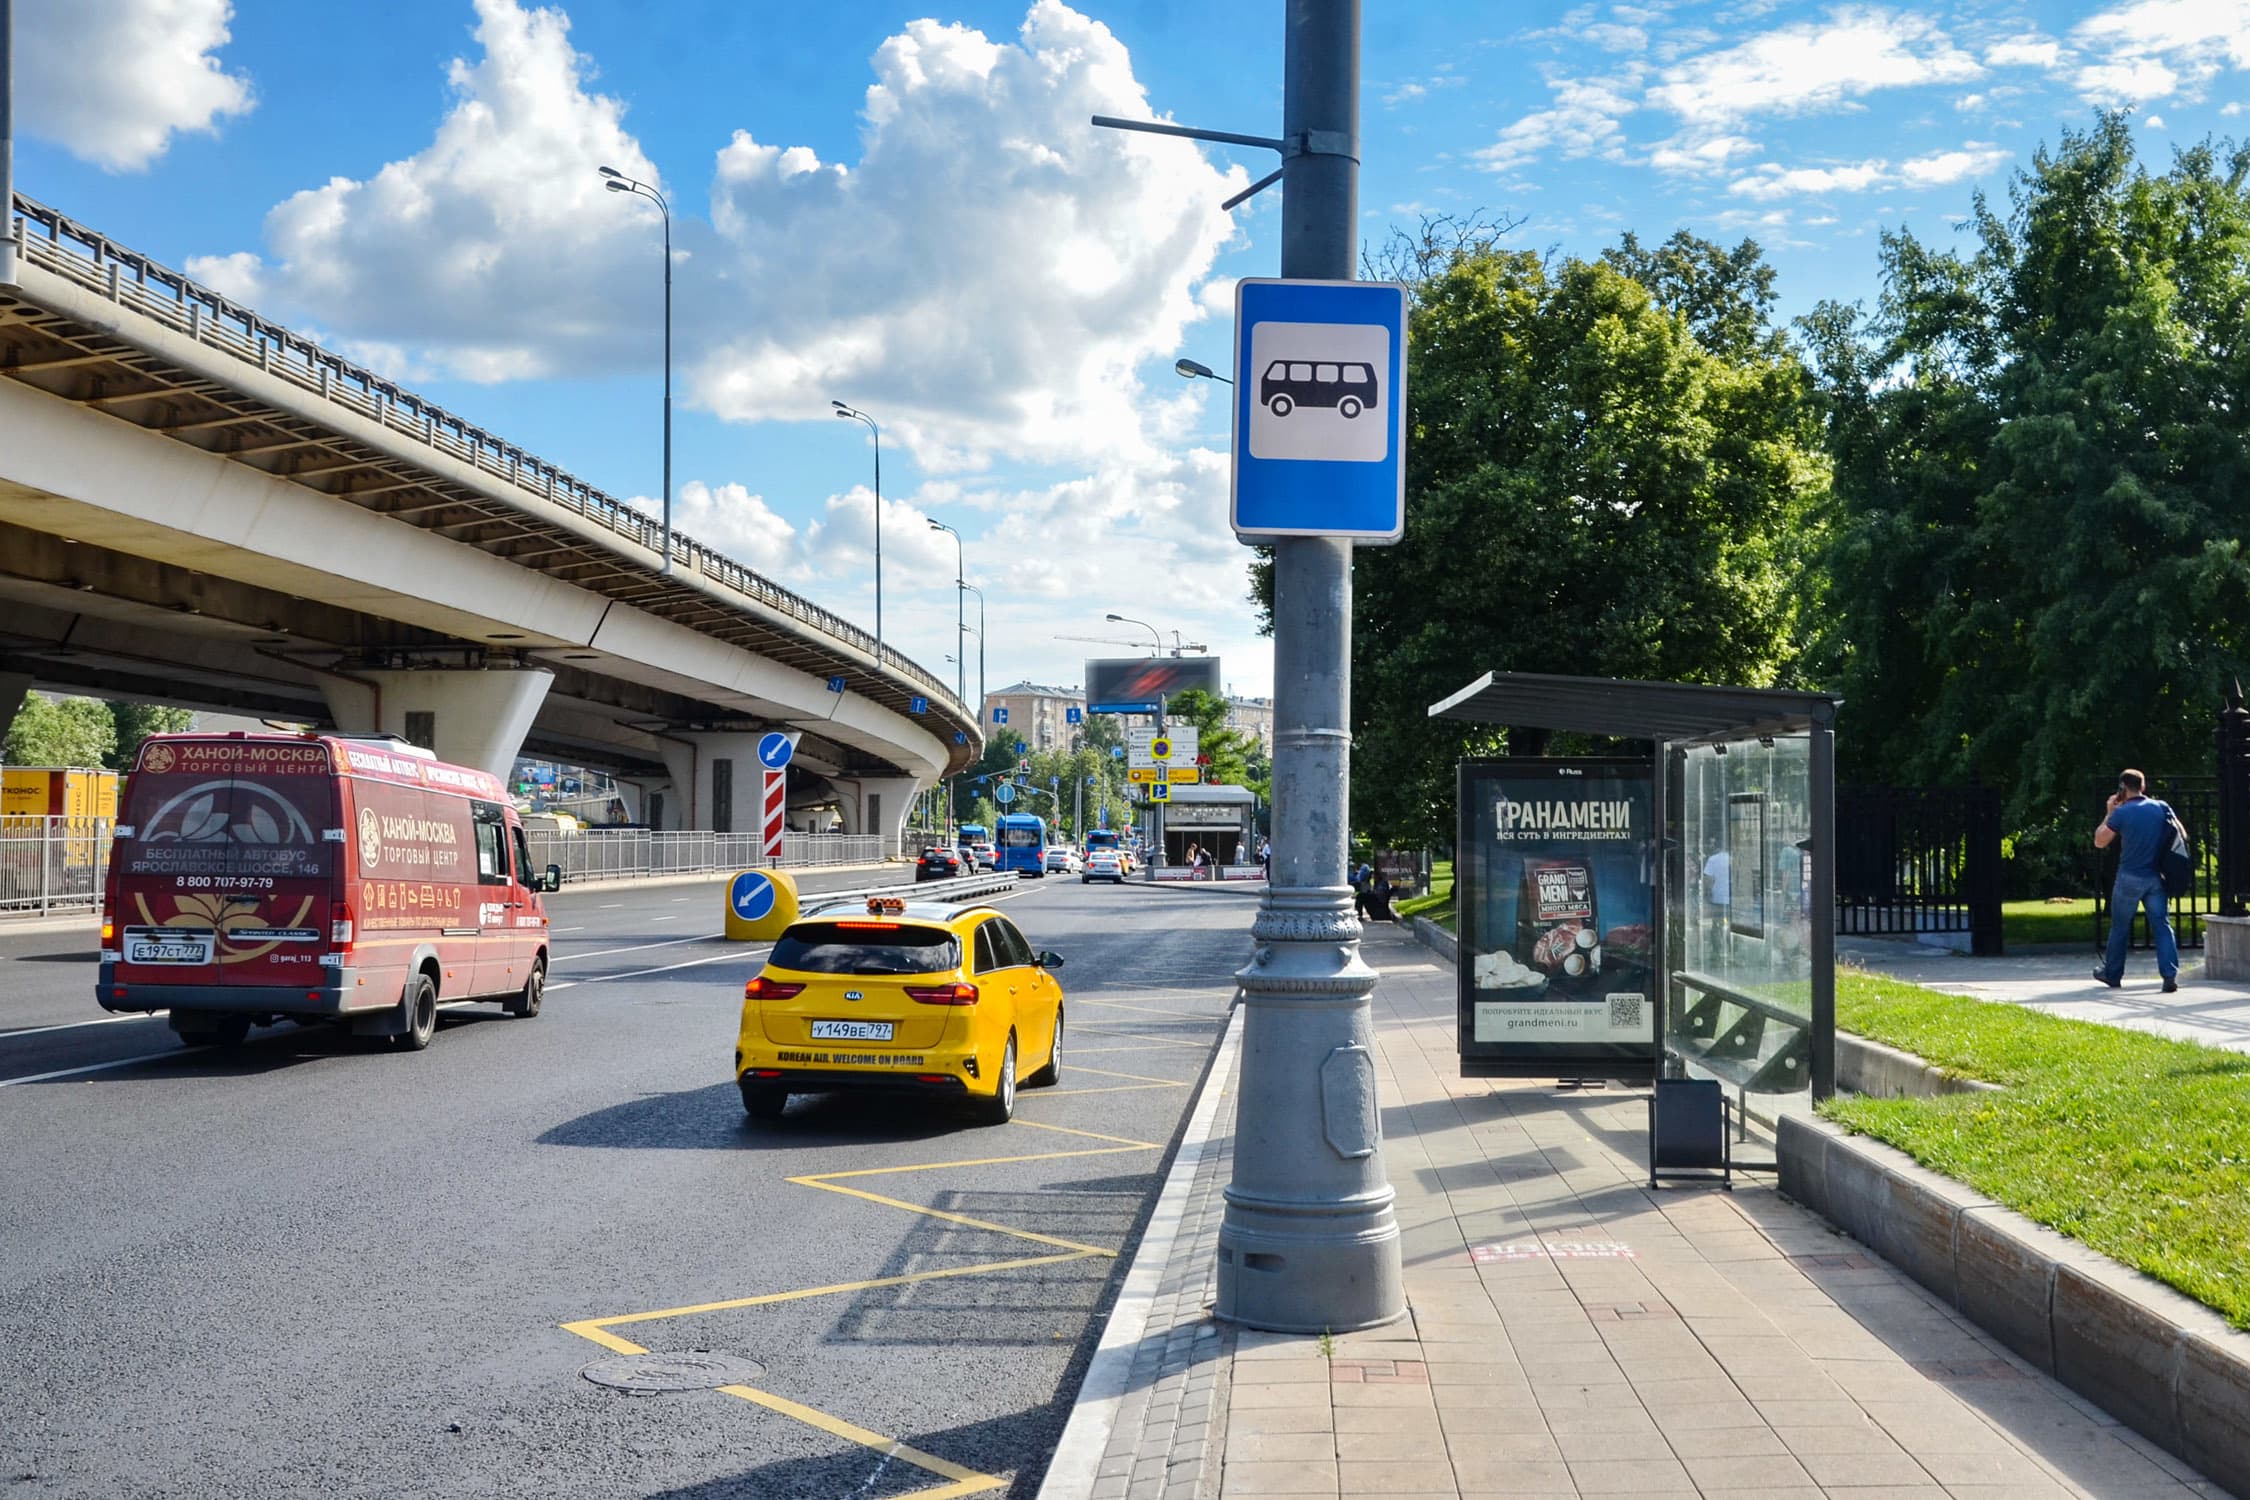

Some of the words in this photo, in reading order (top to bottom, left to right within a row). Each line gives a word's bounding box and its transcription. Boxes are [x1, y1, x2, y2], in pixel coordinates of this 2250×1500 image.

[182, 745, 327, 760] ХАНОЙ-МОСКВА
[181, 762, 268, 772] ТОРГОВЫЙ
[276, 764, 328, 774] ЦЕНТР
[1496, 801, 1630, 829] ГРАНДМЕНИ
[381, 814, 456, 844] ХАНОЙ-МОСКВА
[1517, 831, 1540, 840] СУТЬ
[146, 848, 240, 861] БЕСПЛАТНЫЙ
[244, 850, 307, 861] АВТОБУС
[384, 846, 430, 865] ТОРГОВЫЙ
[434, 851, 458, 867] ЦЕНТР
[131, 861, 233, 874] ЯРОСЛАВСКОЕ
[238, 863, 292, 875] ШОССЕ,
[299, 863, 319, 874] 146
[176, 876, 184, 886] 8
[187, 876, 210, 887] 800
[214, 877, 273, 888] 707-97-79
[1537, 874, 1567, 885] GRAND
[1540, 885, 1569, 903] MENI
[845, 991, 861, 1000] KIA
[1507, 1018, 1578, 1029] grandmeni.ru
[777, 1051, 812, 1063] KOREAN
[832, 1053, 877, 1064] WELCOME
[879, 1055, 891, 1065] ON
[893, 1055, 924, 1066] BOARD
